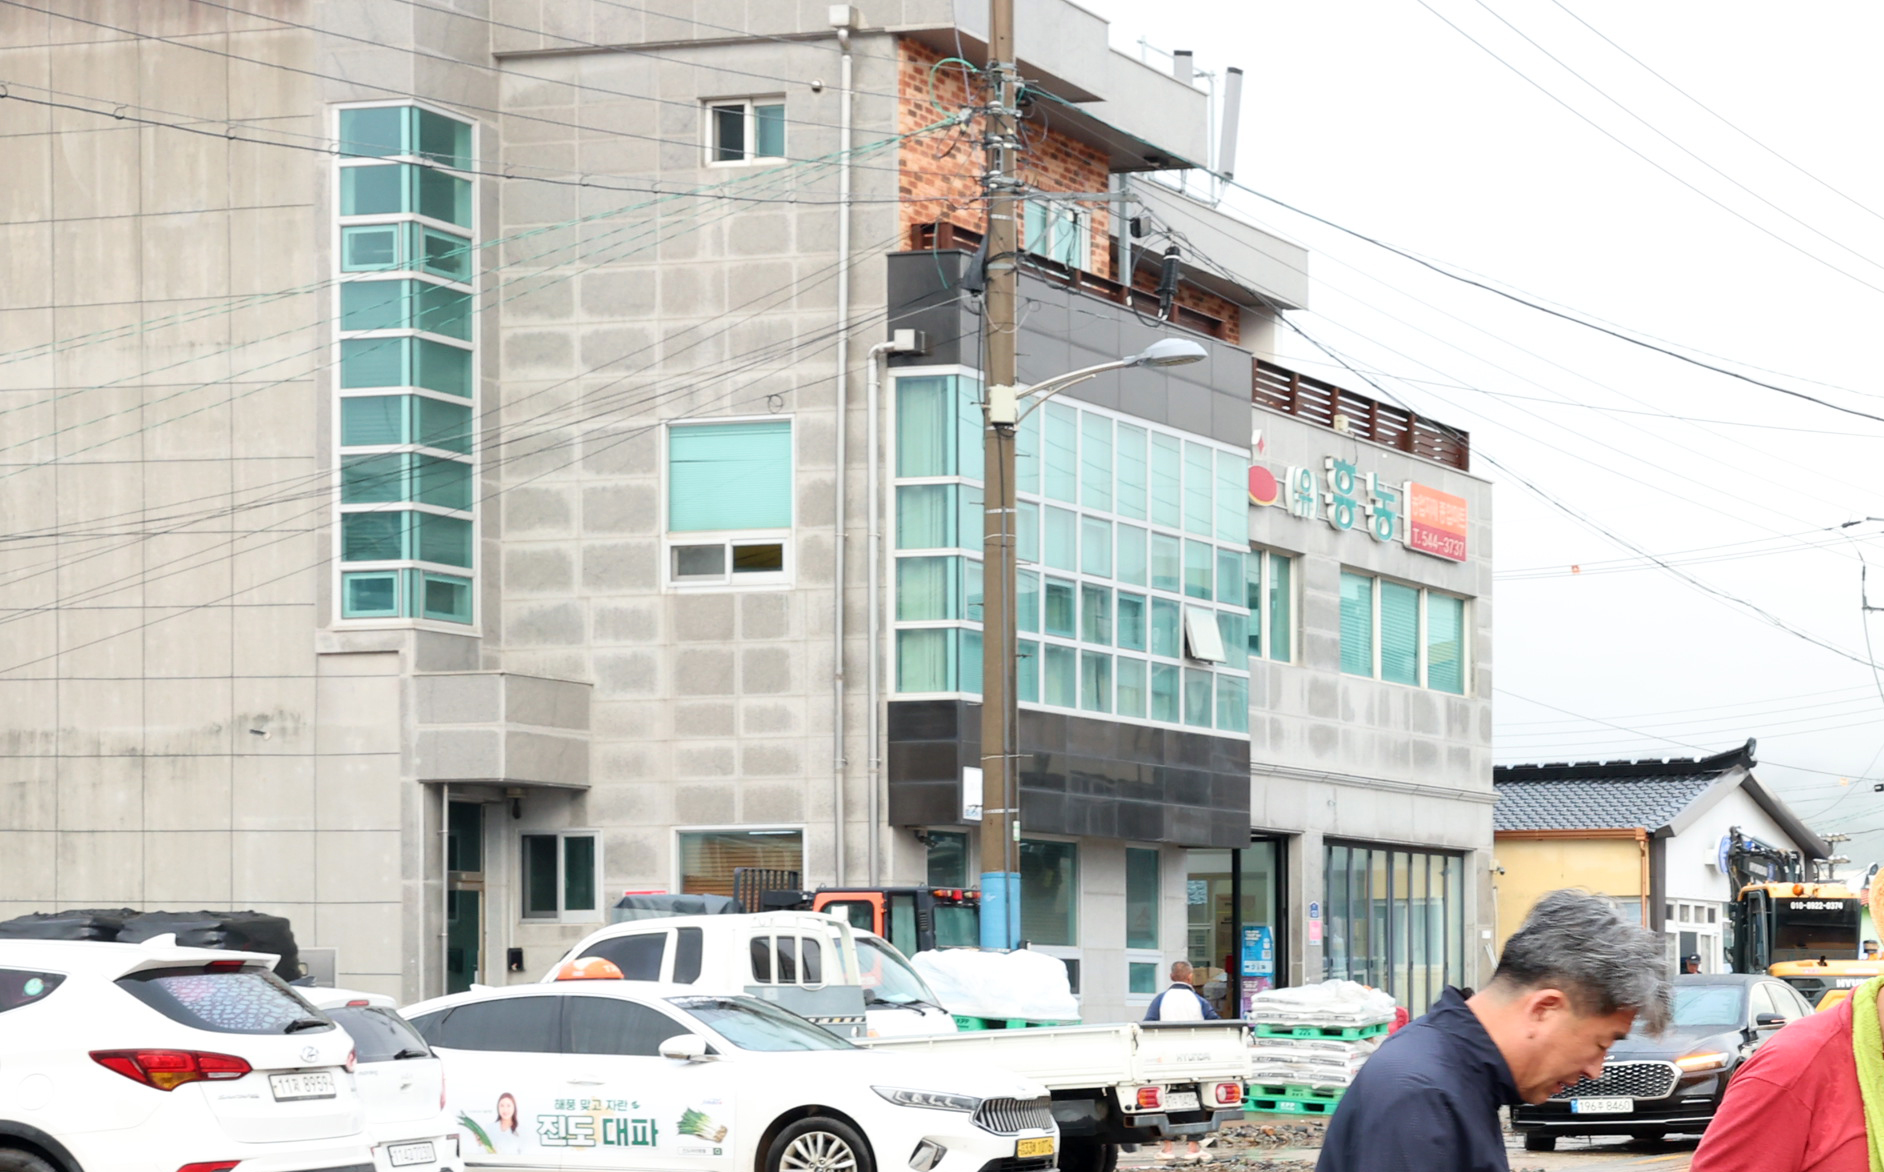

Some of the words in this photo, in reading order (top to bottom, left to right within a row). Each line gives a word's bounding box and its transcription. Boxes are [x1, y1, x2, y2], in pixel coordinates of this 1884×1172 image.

[1411, 527, 1465, 557] T.544-3737
[554, 1098, 576, 1111] 해풍
[580, 1098, 602, 1111] 맞고
[606, 1099, 628, 1112] 자란
[1606, 1100, 1630, 1111] 8460
[536, 1114, 597, 1147] 진도
[602, 1117, 659, 1147] 대파
